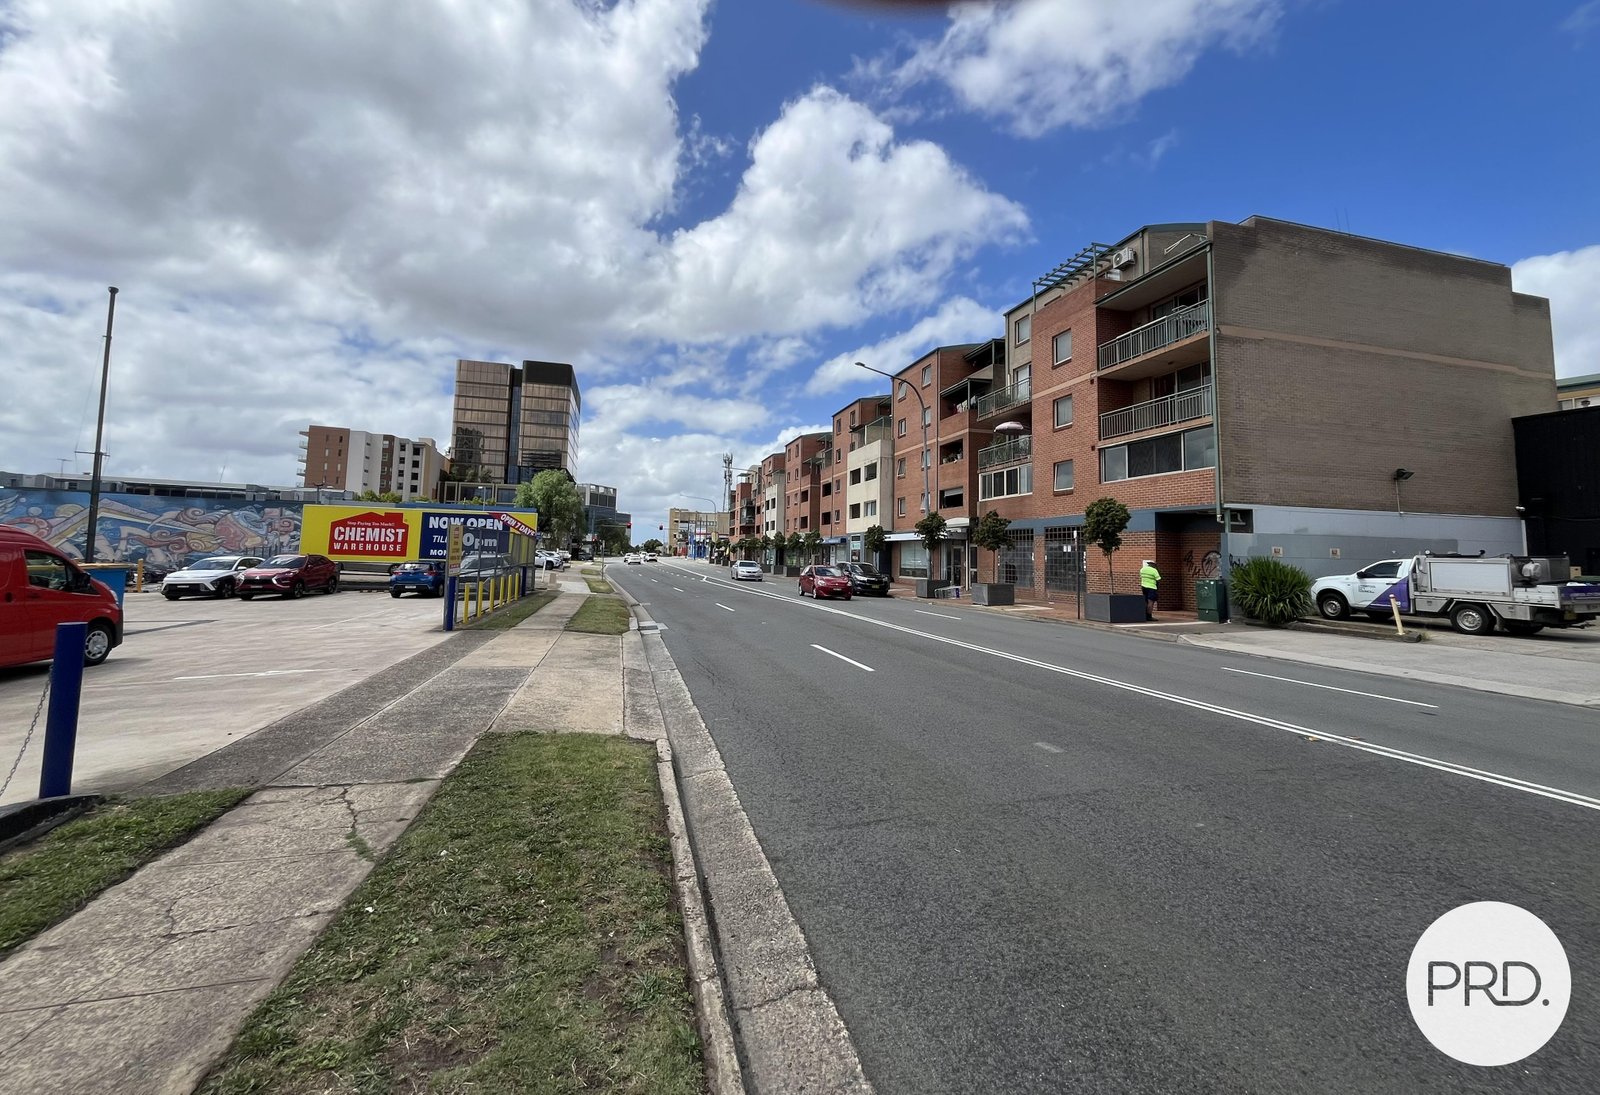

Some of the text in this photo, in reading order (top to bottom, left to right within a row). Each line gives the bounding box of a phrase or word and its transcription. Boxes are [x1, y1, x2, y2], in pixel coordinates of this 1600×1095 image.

[429, 516, 503, 530] NOW OPEN
[501, 514, 516, 527] OPEN
[334, 526, 405, 542] CHEMIST
[463, 532, 497, 549] 0pm
[333, 542, 402, 552] WAREHOUSE
